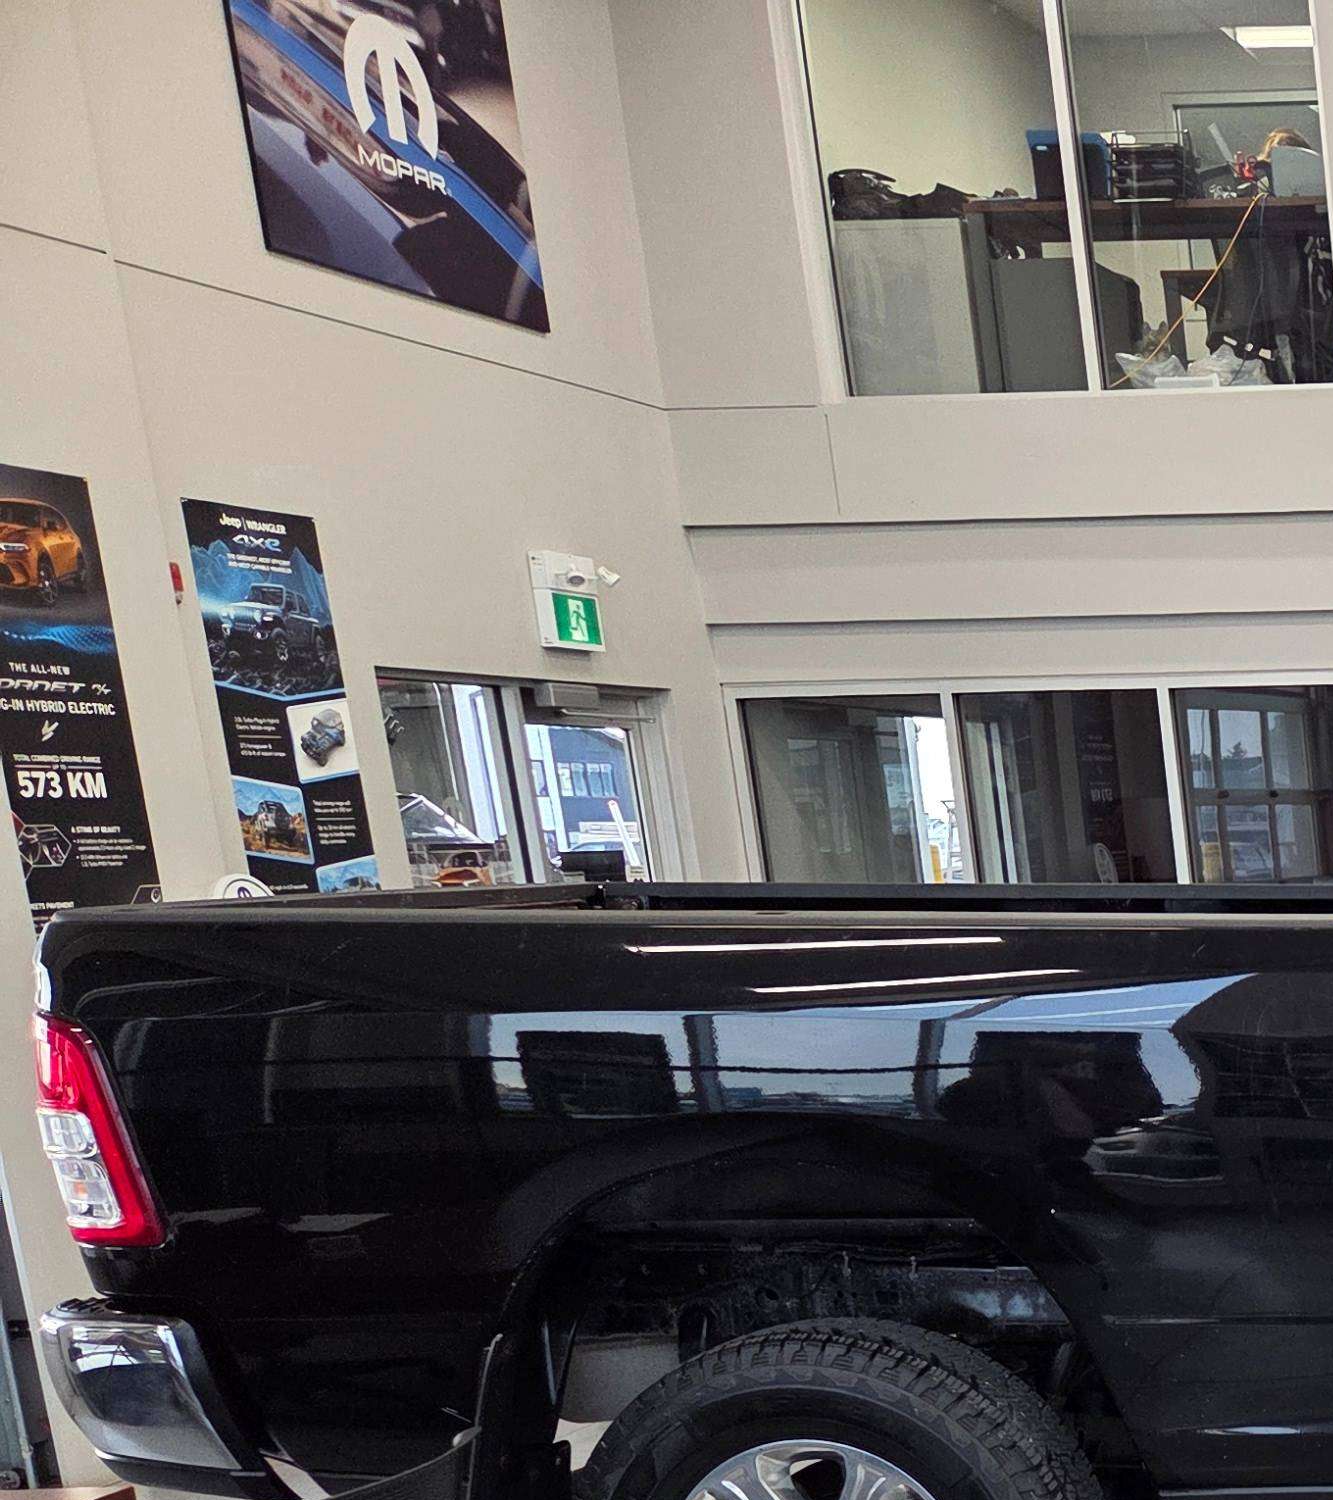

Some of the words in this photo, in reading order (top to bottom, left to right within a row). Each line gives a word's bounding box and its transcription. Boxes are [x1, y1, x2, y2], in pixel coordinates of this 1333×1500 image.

[356, 144, 448, 196] MOPAR
[8, 662, 27, 673] THE
[30, 664, 70, 675] ALL-NEW
[26, 700, 66, 714] HYBRID
[69, 701, 116, 716] ELECTRIC
[17, 771, 63, 798] 573
[66, 772, 108, 798] KM
